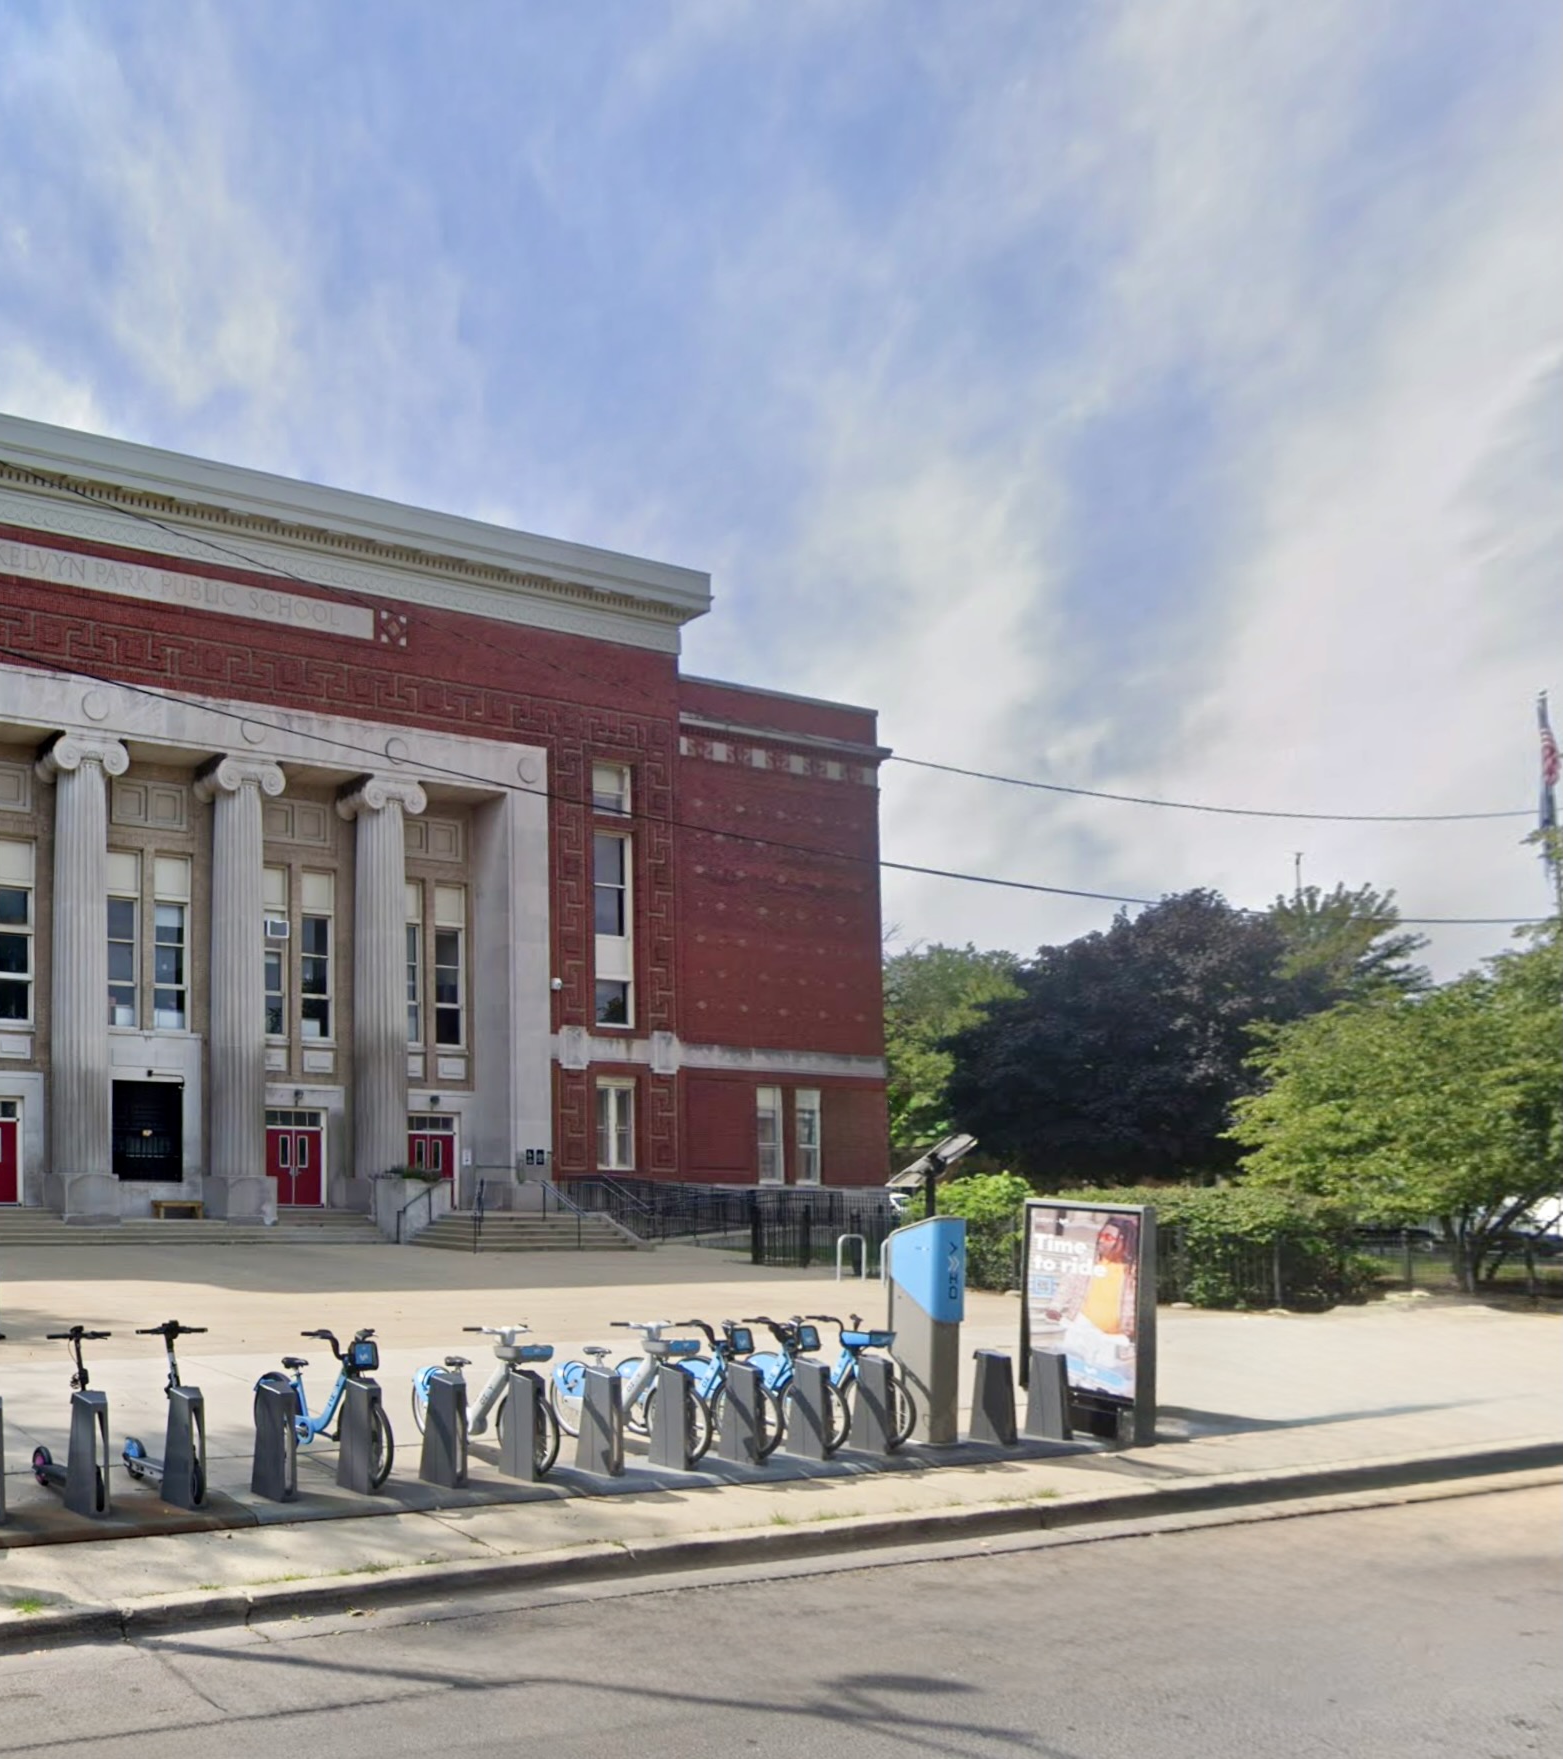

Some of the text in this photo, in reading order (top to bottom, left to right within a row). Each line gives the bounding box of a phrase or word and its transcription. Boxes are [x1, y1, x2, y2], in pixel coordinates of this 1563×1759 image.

[94, 561, 151, 593] PARK
[160, 573, 237, 608] PUBLIC
[248, 590, 341, 627] SCHOOL
[1034, 1233, 1087, 1255] Time
[1034, 1254, 1107, 1277] to ride
